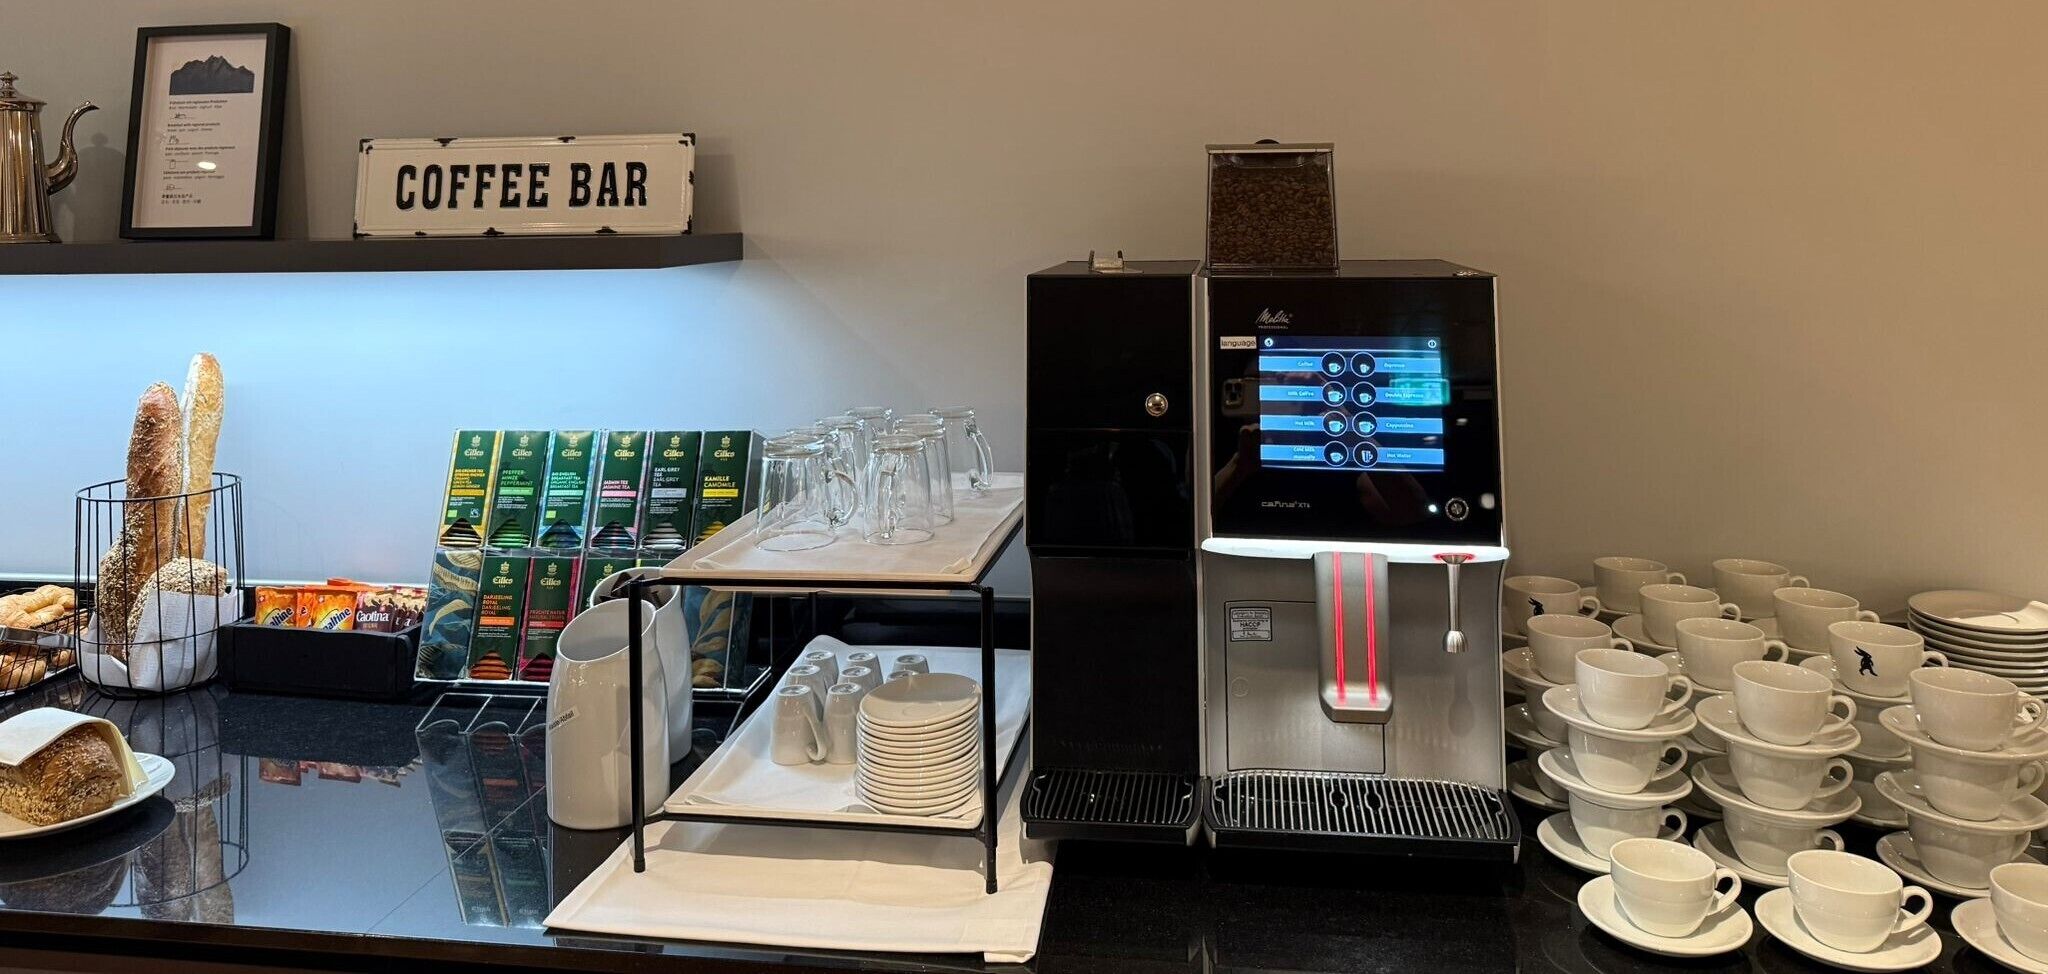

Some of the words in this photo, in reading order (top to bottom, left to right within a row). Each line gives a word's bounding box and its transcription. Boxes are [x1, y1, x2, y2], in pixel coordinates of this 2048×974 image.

[396, 163, 550, 210] COFFEE
[568, 162, 648, 207] BAR
[1256, 308, 1289, 324] Melitta
[1221, 339, 1256, 348] language
[492, 576, 513, 585] Eilles
[540, 577, 561, 586] Eilles
[270, 607, 293, 626] altine
[356, 610, 389, 622] Caotina
